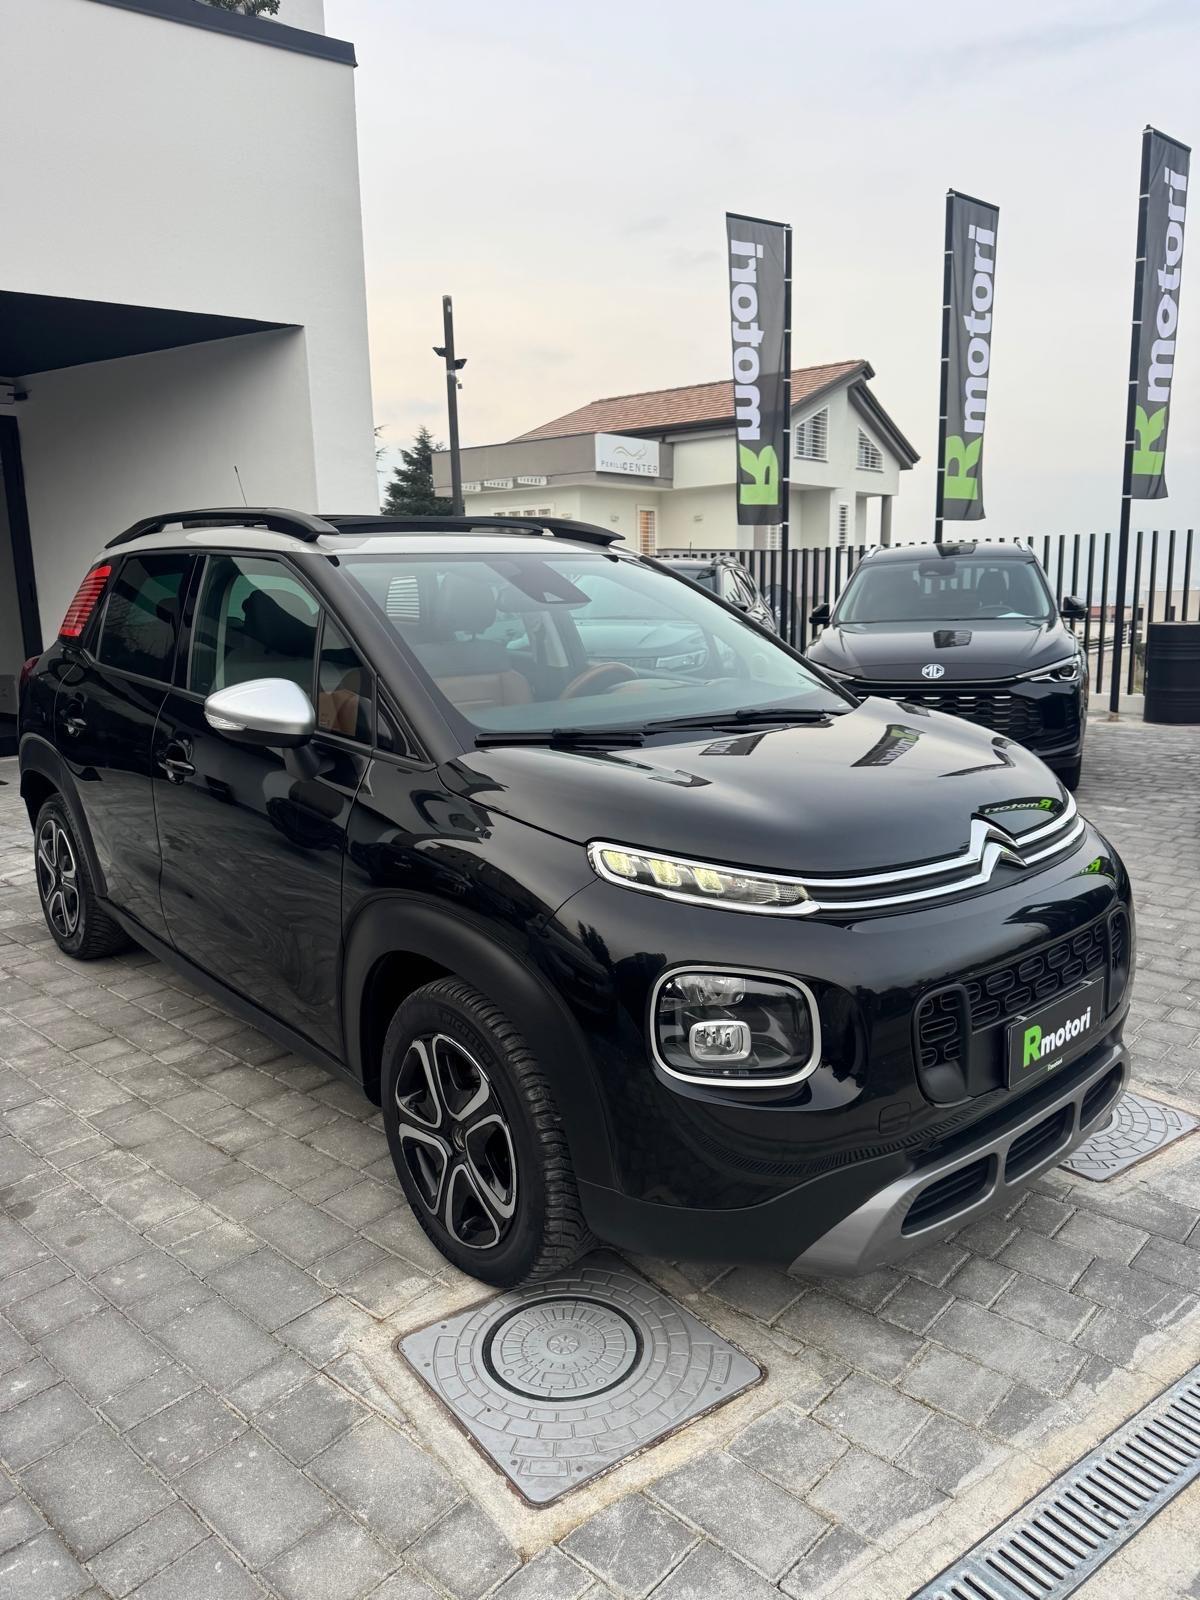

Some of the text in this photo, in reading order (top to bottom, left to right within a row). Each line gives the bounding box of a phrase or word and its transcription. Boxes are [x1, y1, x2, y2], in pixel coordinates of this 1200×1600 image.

[944, 224, 995, 500] Rmotori
[623, 461, 658, 474] CENTER
[921, 663, 945, 679] MG
[1023, 1006, 1092, 1068] Rmotori
